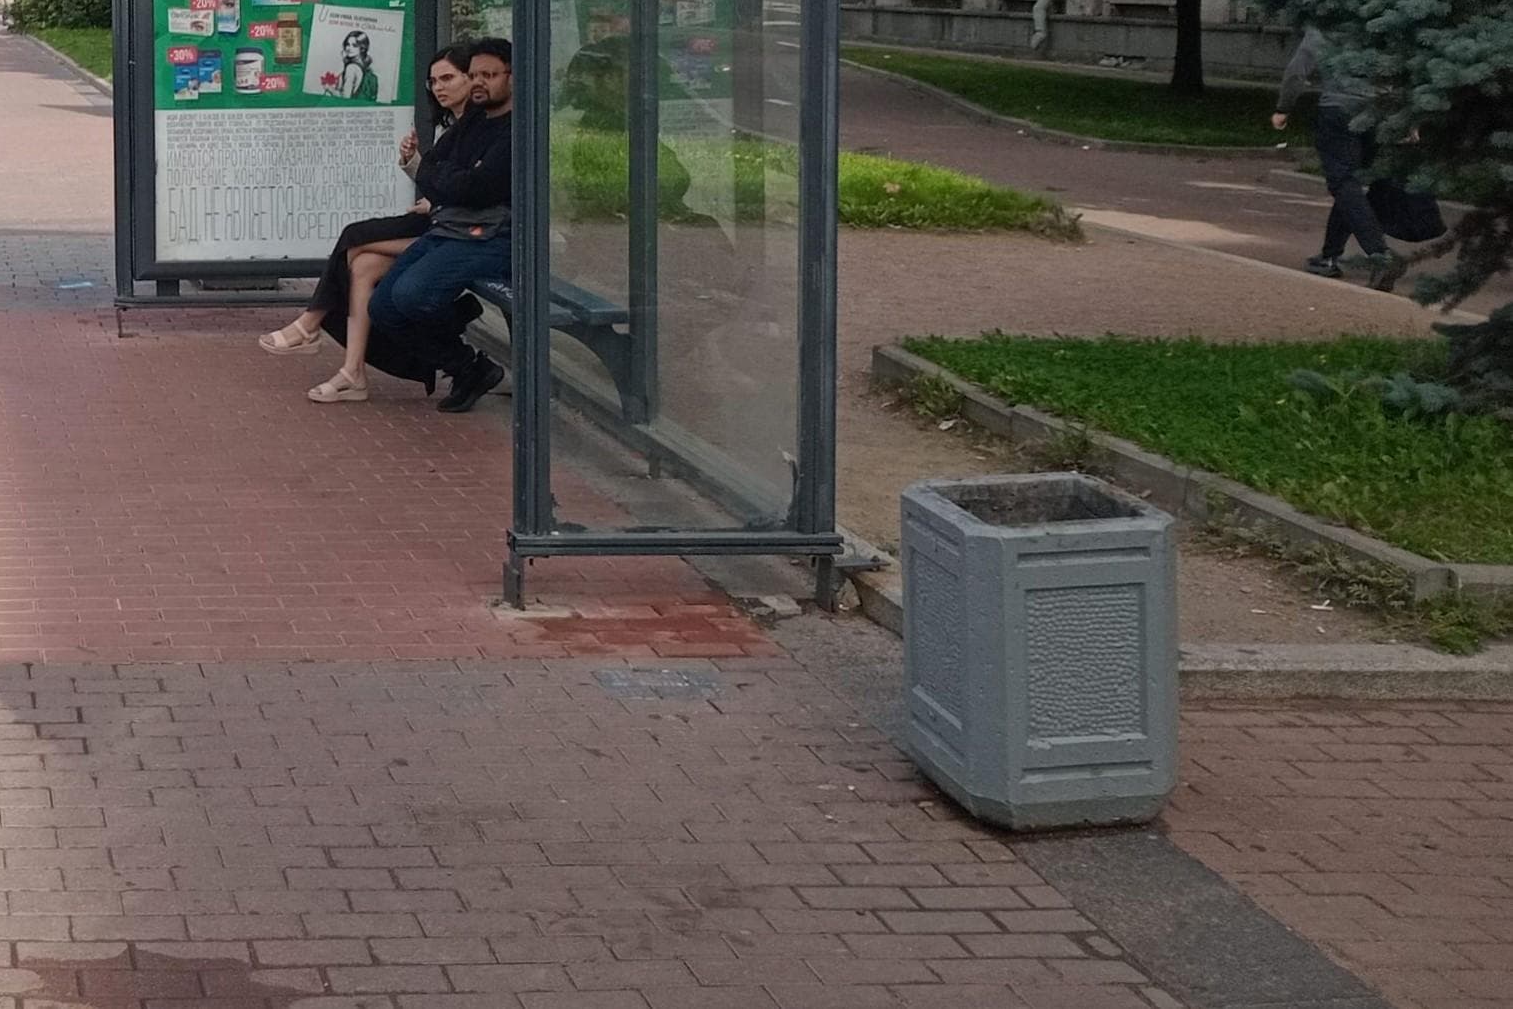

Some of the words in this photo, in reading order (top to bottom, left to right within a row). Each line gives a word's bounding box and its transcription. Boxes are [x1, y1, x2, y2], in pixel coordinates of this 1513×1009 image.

[250, 26, 276, 38] -20%
[169, 49, 194, 61] -30%
[261, 77, 286, 89] -20%
[167, 149, 215, 168] ИМЕЮТСЯ
[327, 146, 396, 166] НЕОБХОДИМО
[167, 168, 228, 186] ПОЛУЧЕНИЕ
[234, 166, 315, 185] КОНСУЛЬТАЦИИ
[322, 165, 398, 184] СПЕЦИАЛИСТА
[204, 187, 220, 241] НЕ
[225, 186, 293, 241] ЯВЛЯЕТСЯ
[297, 184, 397, 211] ЛЕКАРСТВЕННЫМ
